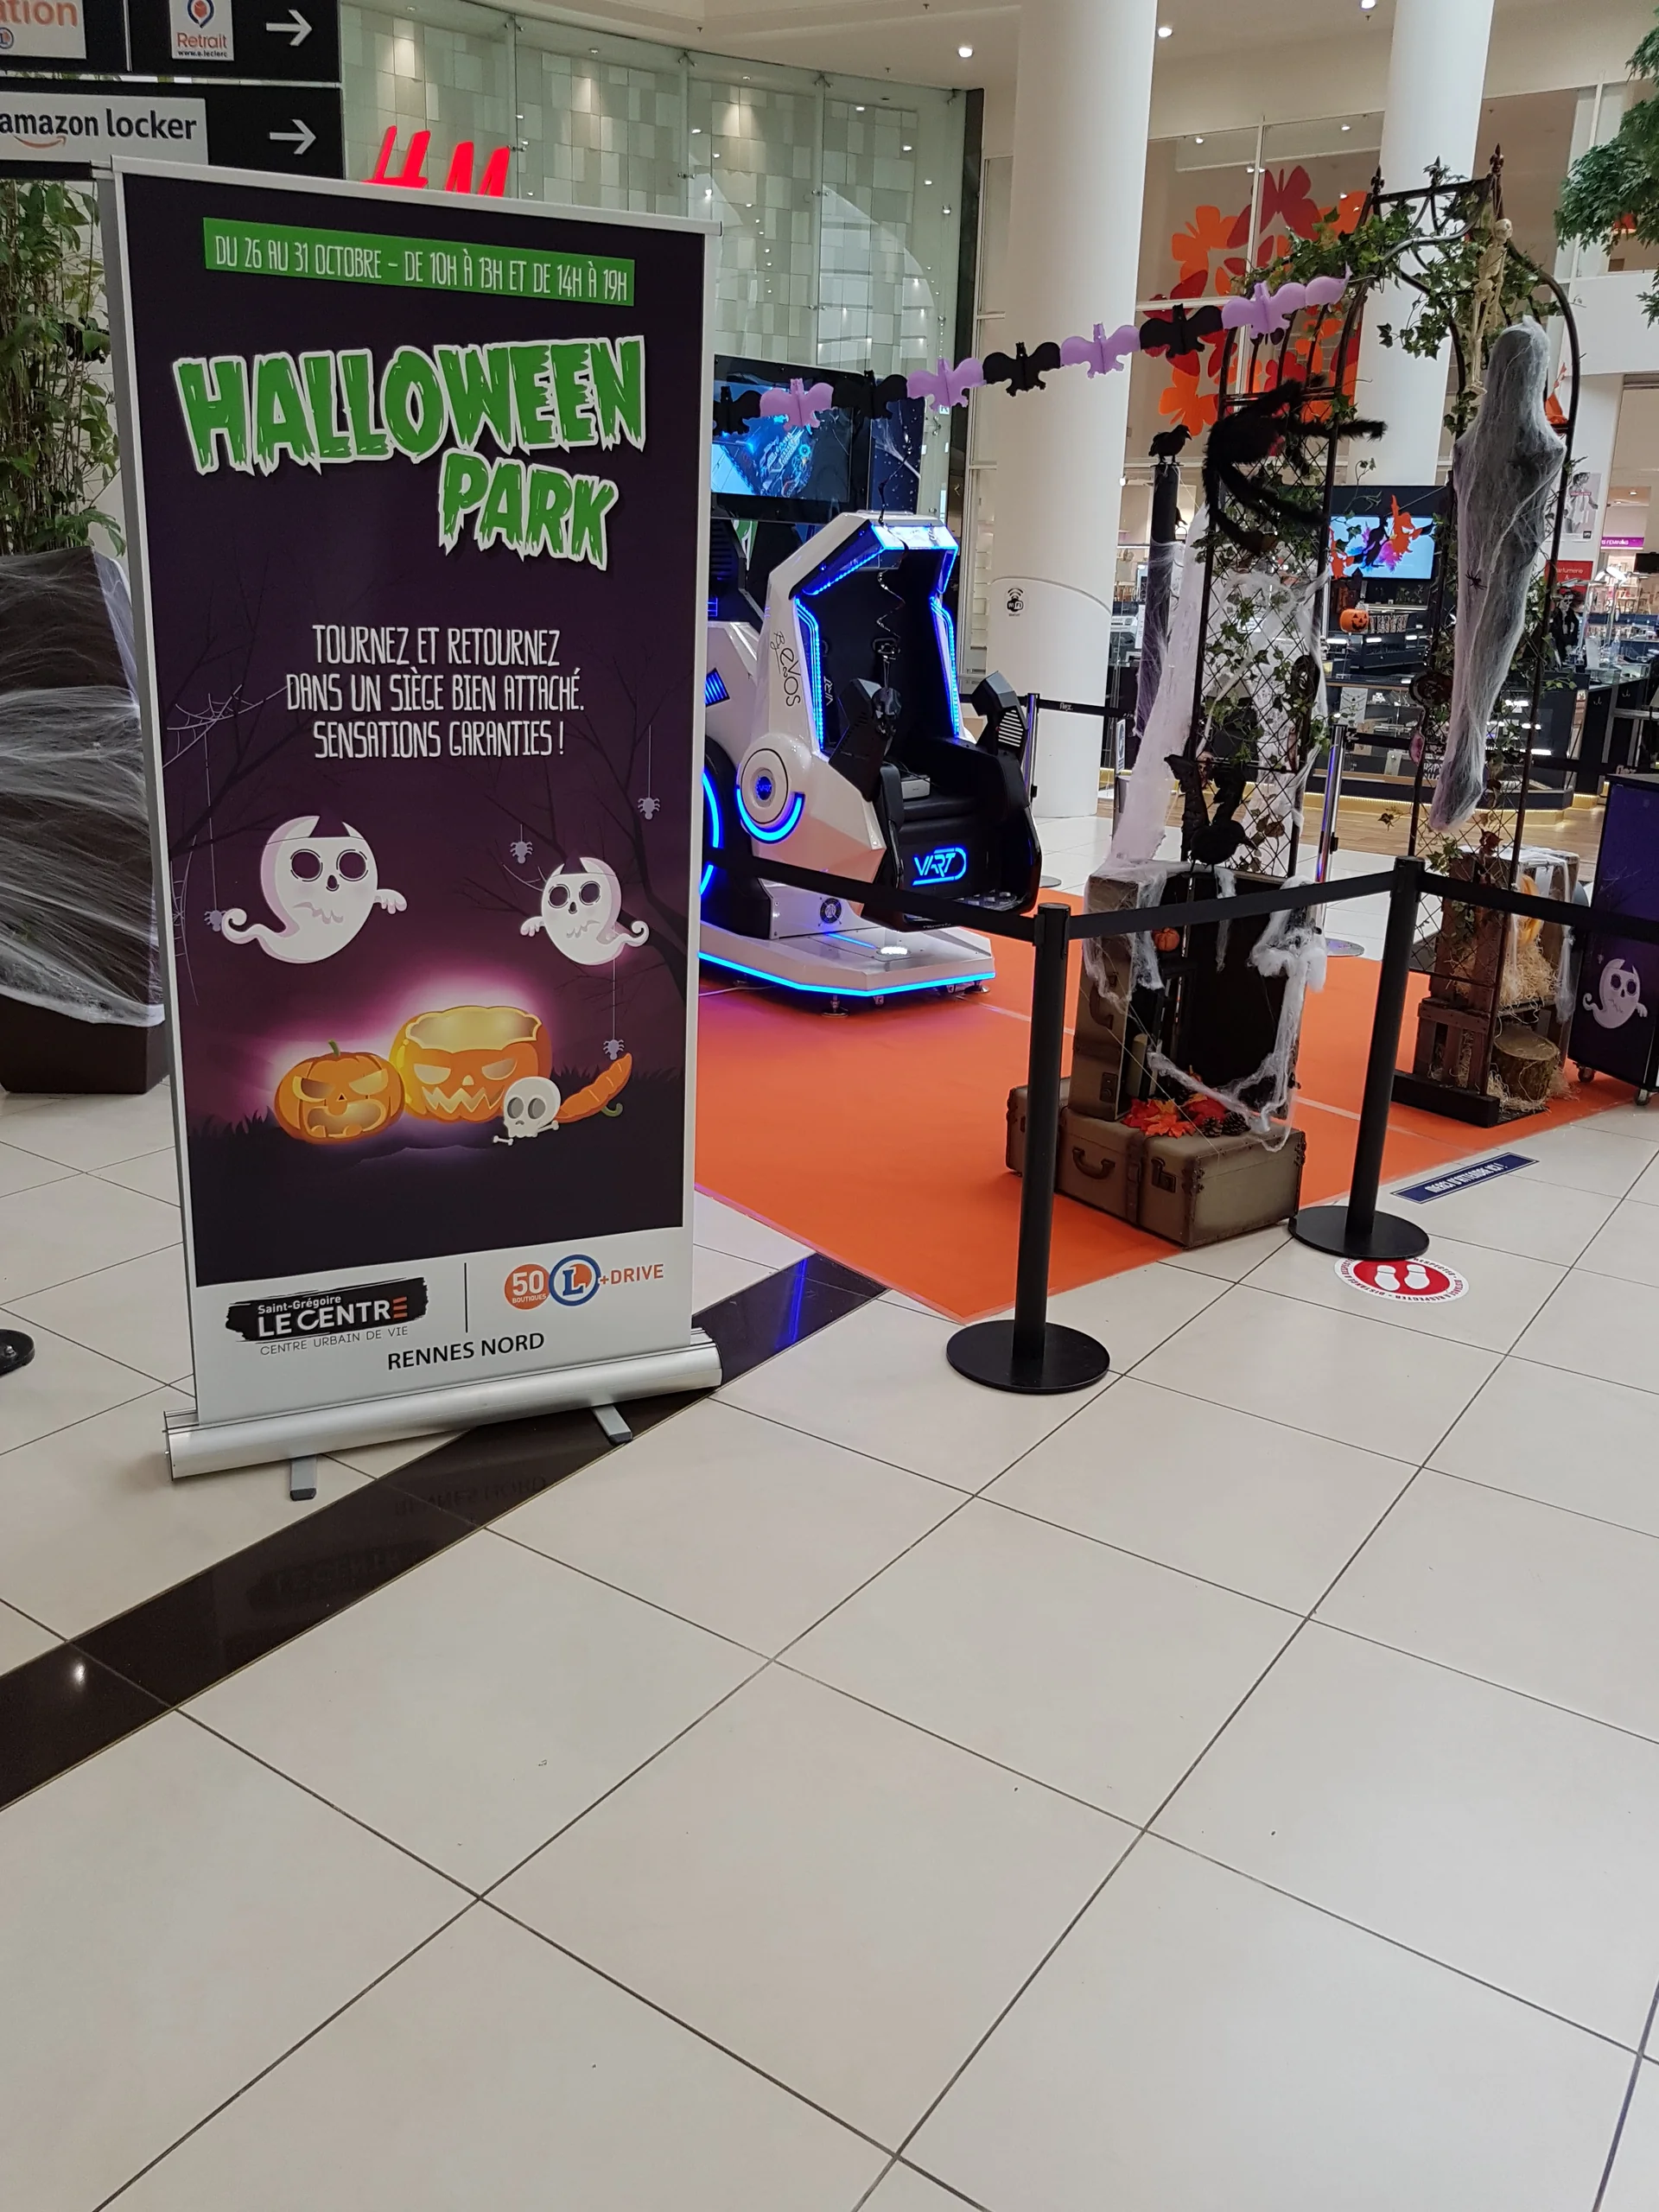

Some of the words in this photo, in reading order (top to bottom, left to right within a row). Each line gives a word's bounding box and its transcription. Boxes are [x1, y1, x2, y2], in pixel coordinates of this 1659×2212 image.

[176, 32, 227, 48] Retrait
[0, 113, 99, 137] amazon
[105, 108, 196, 140] locker
[215, 236, 237, 266] DU
[245, 238, 262, 268] 26
[268, 239, 289, 270] AU
[294, 241, 309, 273] 31
[315, 245, 381, 278] OCTOBRE
[404, 251, 423, 283] DE
[429, 252, 456, 286] 10H
[463, 248, 474, 286] À
[480, 257, 503, 290] 13H
[510, 260, 526, 291] ET
[534, 263, 550, 293] DE
[557, 265, 582, 297] 14H
[588, 261, 597, 297] À
[603, 268, 627, 301] 19H
[172, 335, 644, 475] HALLOWEEN
[438, 448, 619, 571] PARK
[312, 625, 410, 665] TOURNEZ
[417, 627, 440, 664] ET
[448, 628, 561, 667] RETOURNEZ
[286, 673, 341, 711] DANS
[351, 675, 381, 712] UN
[390, 666, 444, 712] SIÈGE
[452, 675, 496, 712] BIEN
[504, 667, 584, 711] ATTACHÉ.
[313, 721, 441, 759] SENSATIONS
[448, 721, 552, 757] GARANTIES
[559, 721, 564, 755] !
[512, 1269, 544, 1296] 50
[512, 1294, 547, 1304] BOUTIQUES
[563, 1269, 584, 1296] L
[257, 1295, 341, 1314] Saint-Grégoire
[258, 1313, 292, 1338] LE
[297, 1296, 408, 1331] CENTRE
[260, 1340, 308, 1356] CENTRE
[314, 1332, 360, 1348] URBAIN
[366, 1329, 382, 1340] DE
[388, 1325, 409, 1338] VIE
[388, 1341, 474, 1370] RENNES
[481, 1332, 545, 1360] NORD
